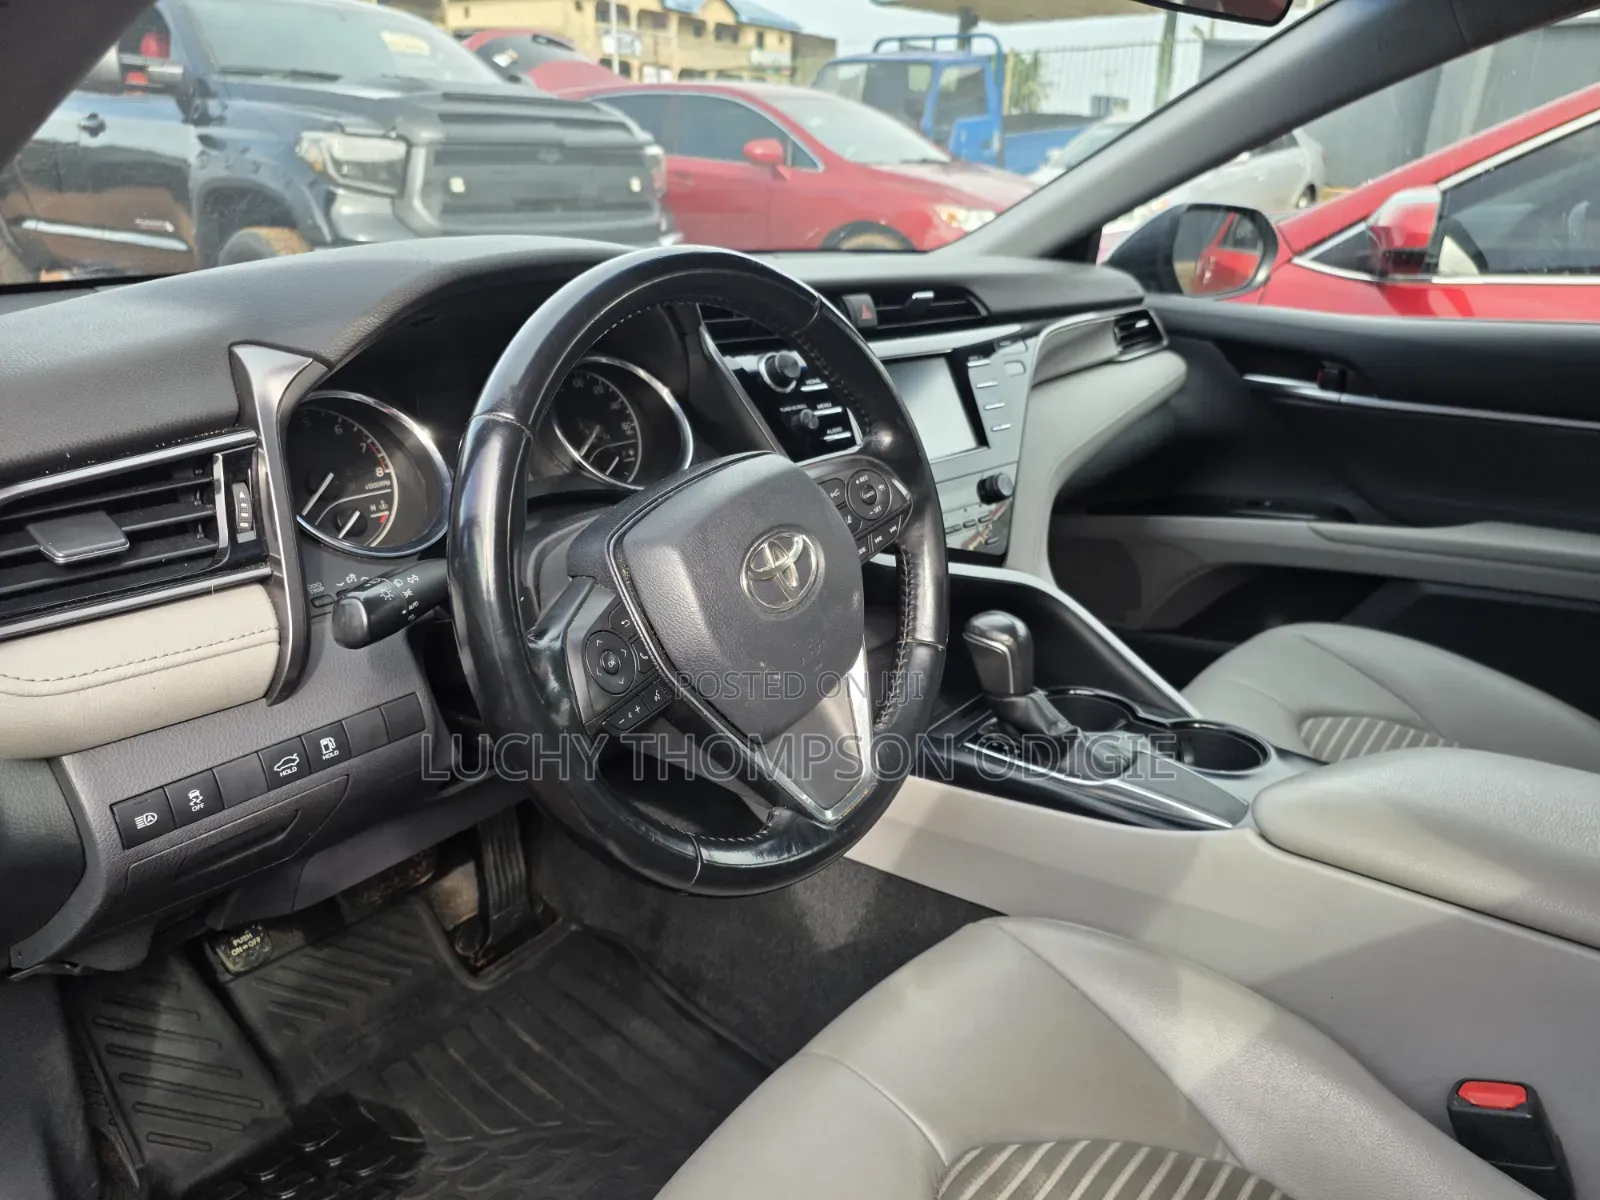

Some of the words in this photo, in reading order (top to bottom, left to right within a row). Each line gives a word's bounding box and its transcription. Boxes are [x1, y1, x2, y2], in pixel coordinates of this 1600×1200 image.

[334, 424, 343, 434] 6
[360, 442, 367, 453] 7
[375, 467, 384, 477] 8
[309, 586, 324, 595] TRIP
[323, 750, 339, 760] HOLD
[280, 767, 298, 777] HOLD
[191, 803, 204, 811] OFF
[233, 933, 252, 945] PUSH
